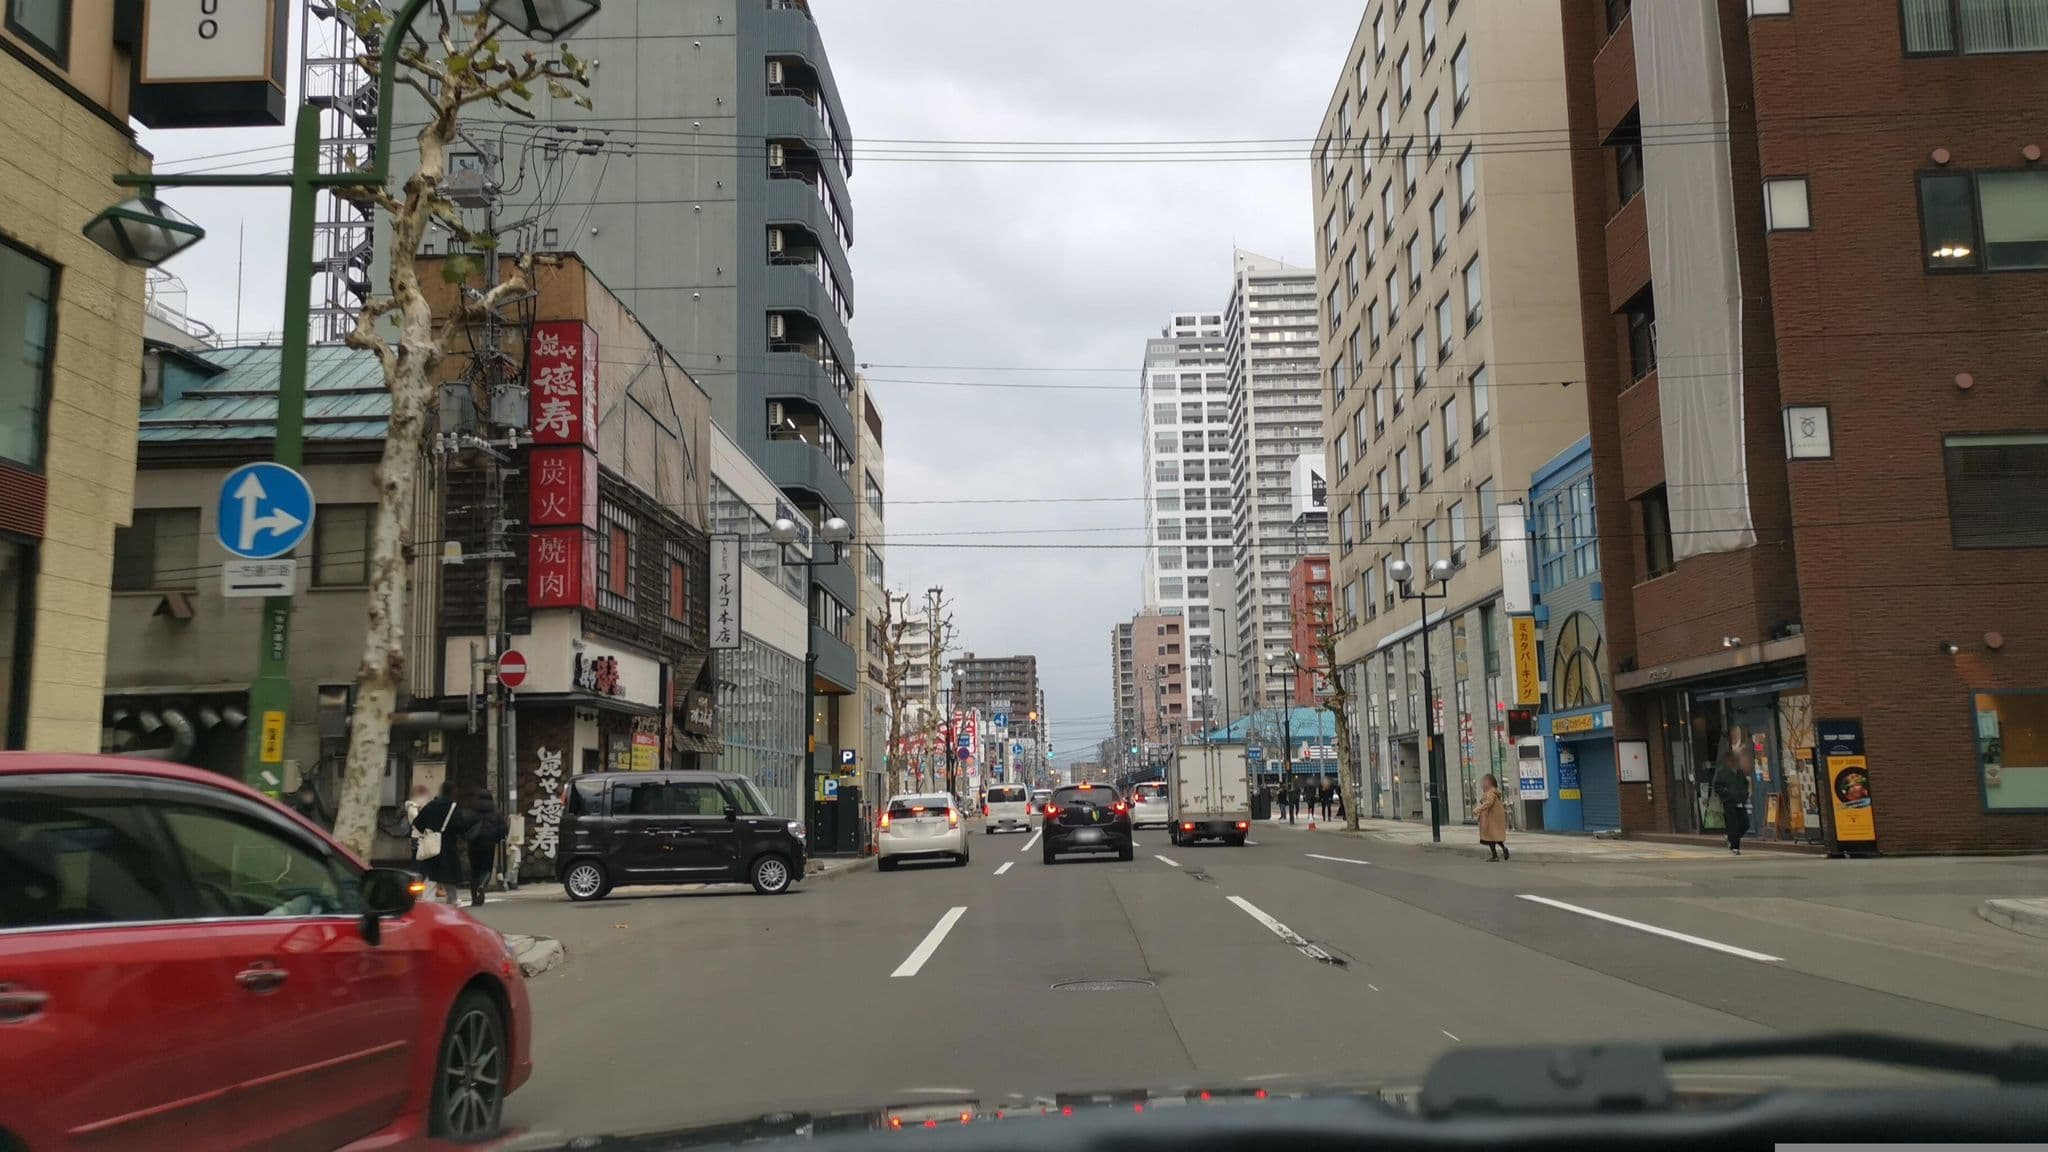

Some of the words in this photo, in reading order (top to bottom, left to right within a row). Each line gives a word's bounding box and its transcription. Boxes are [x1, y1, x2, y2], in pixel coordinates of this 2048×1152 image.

[539, 458, 567, 518] 炭火
[843, 751, 853, 763] P
[824, 780, 838, 795] P
